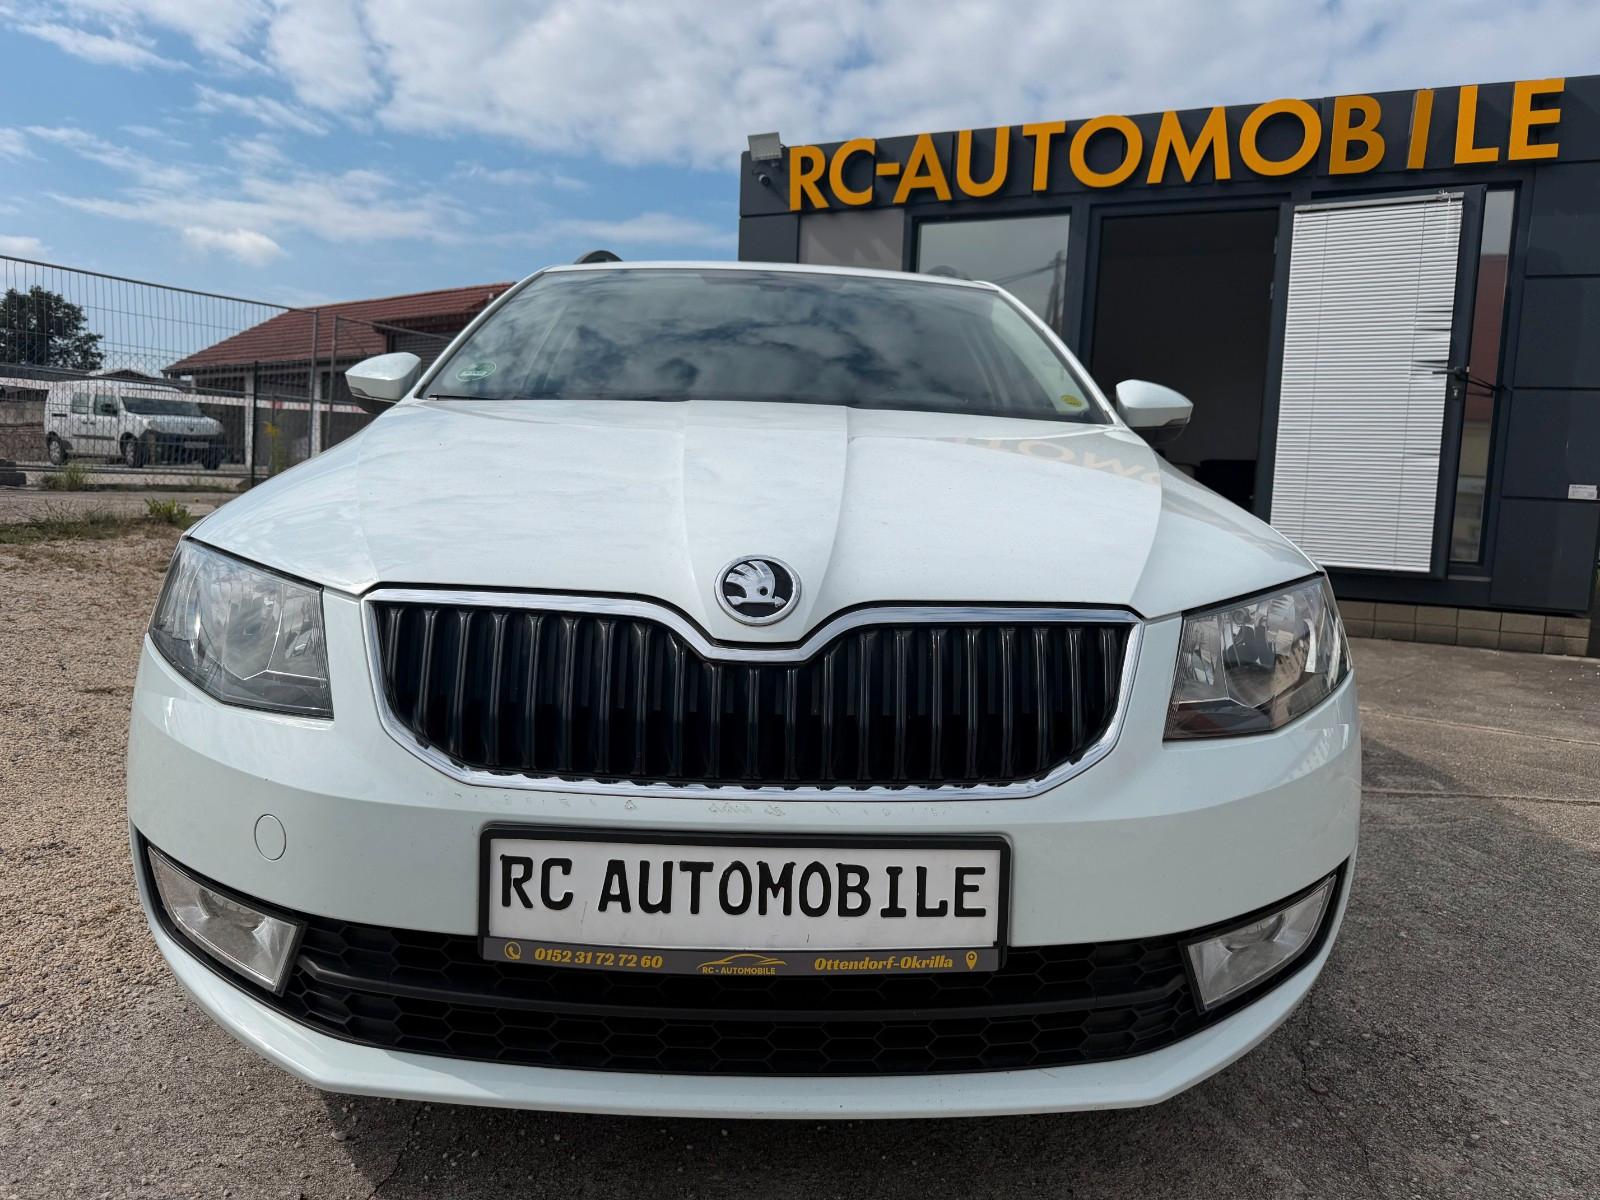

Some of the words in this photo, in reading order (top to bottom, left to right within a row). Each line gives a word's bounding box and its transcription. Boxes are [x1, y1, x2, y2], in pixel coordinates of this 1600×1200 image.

[788, 78, 1566, 211] RC-AUTOMOBILE
[500, 854, 573, 911] RC
[597, 859, 987, 919] AUTOMOBILE
[534, 947, 572, 963] 0152
[574, 951, 593, 964] 31
[595, 952, 616, 966] 72
[618, 953, 638, 968] 72
[640, 955, 663, 969] 60
[814, 956, 953, 971] Ottendorf-Okrilla
